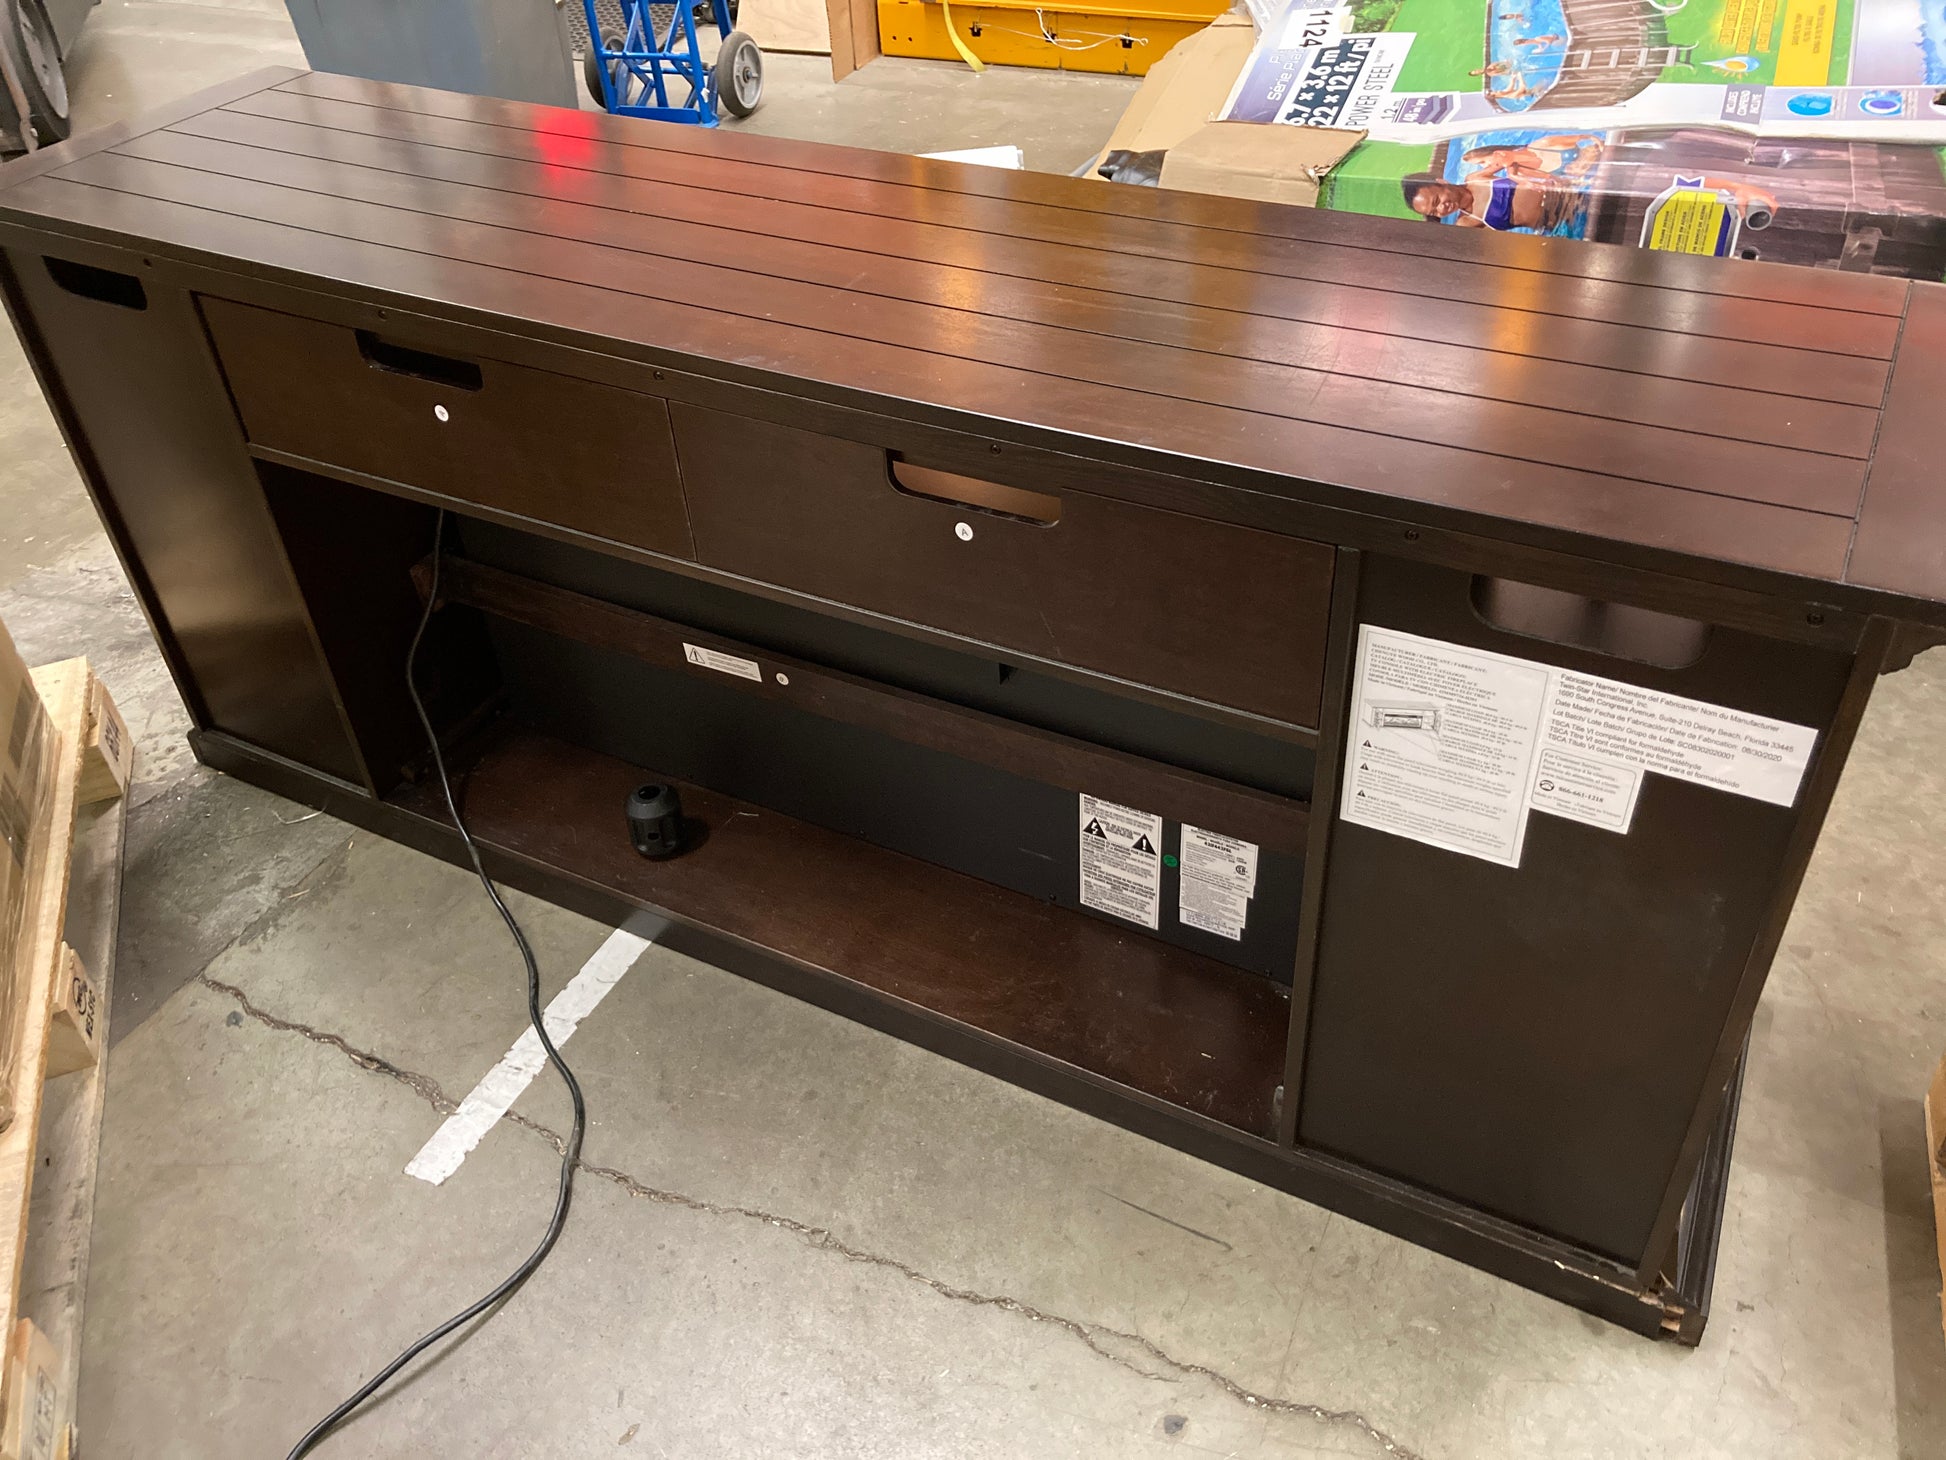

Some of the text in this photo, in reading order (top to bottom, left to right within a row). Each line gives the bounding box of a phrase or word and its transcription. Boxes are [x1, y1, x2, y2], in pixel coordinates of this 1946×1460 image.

[1299, 10, 1332, 47] 1124
[1267, 72, 1292, 101] Série
[1303, 66, 1330, 89] 3.6
[1320, 49, 1340, 62] m
[1310, 105, 1340, 126] 22
[1326, 75, 1355, 91] 12
[1346, 64, 1394, 126] POWER STEEL
[1381, 108, 1397, 119] 1.2
[1558, 681, 1590, 694] Twin-Star
[1560, 673, 1594, 687] Fabricator
[1618, 688, 1646, 700] Nombre
[1700, 707, 1718, 717] Nom
[1718, 712, 1729, 720] du
[1554, 699, 1571, 708] Date
[1593, 708, 1616, 719] Fecha
[1668, 727, 1686, 736] Date
[1574, 693, 1595, 703] South
[1595, 698, 1629, 712] Congress
[1692, 722, 1716, 734] Delray
[1743, 735, 1769, 746] Florida
[1770, 741, 1794, 752] 33445
[1586, 717, 1602, 726] Lote
[1625, 727, 1647, 738] Grupo
[1547, 732, 1567, 742] TSCA
[1595, 746, 1624, 758] cumplen
[1624, 753, 1637, 761] con
[1646, 759, 1668, 769] norma
[1668, 765, 1685, 774] para
[1549, 726, 1569, 735] TSCA
[1569, 731, 1584, 739] Titre
[1584, 734, 1594, 742] VI
[1594, 737, 1609, 746] sont
[1608, 742, 1644, 755] conformes
[1550, 718, 1570, 728] TSCA
[1594, 730, 1627, 744] compliant
[1637, 741, 1685, 759] formaldehyde
[1558, 785, 1604, 803] 866-661-1218
